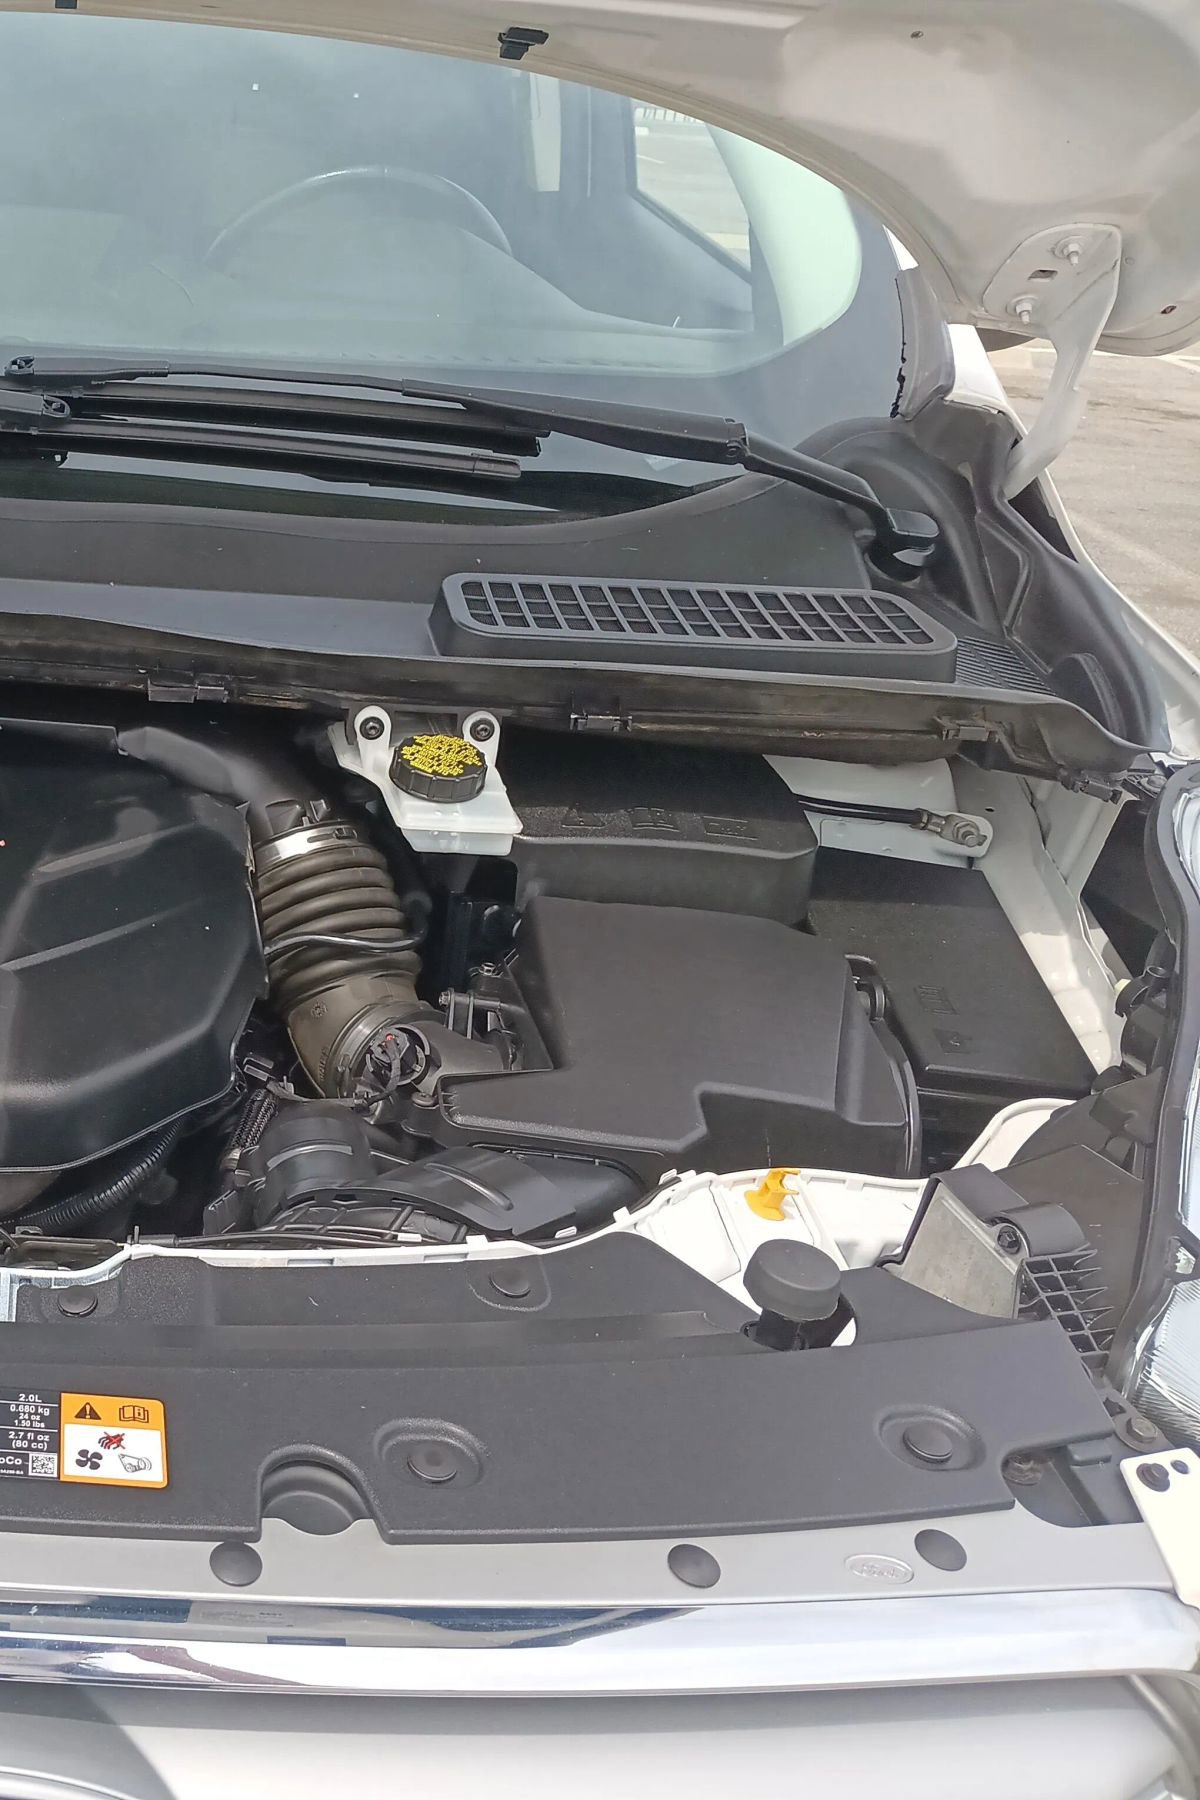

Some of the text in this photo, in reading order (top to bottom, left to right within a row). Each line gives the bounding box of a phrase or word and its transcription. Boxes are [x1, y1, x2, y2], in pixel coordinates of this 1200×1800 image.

[18, 1393, 42, 1403] 2.0L
[10, 1404, 50, 1416] 0.680 kg
[18, 1412, 29, 1420] 24
[8, 1431, 50, 1441] 2.7 fl oz
[12, 1439, 48, 1451] (80 cc)
